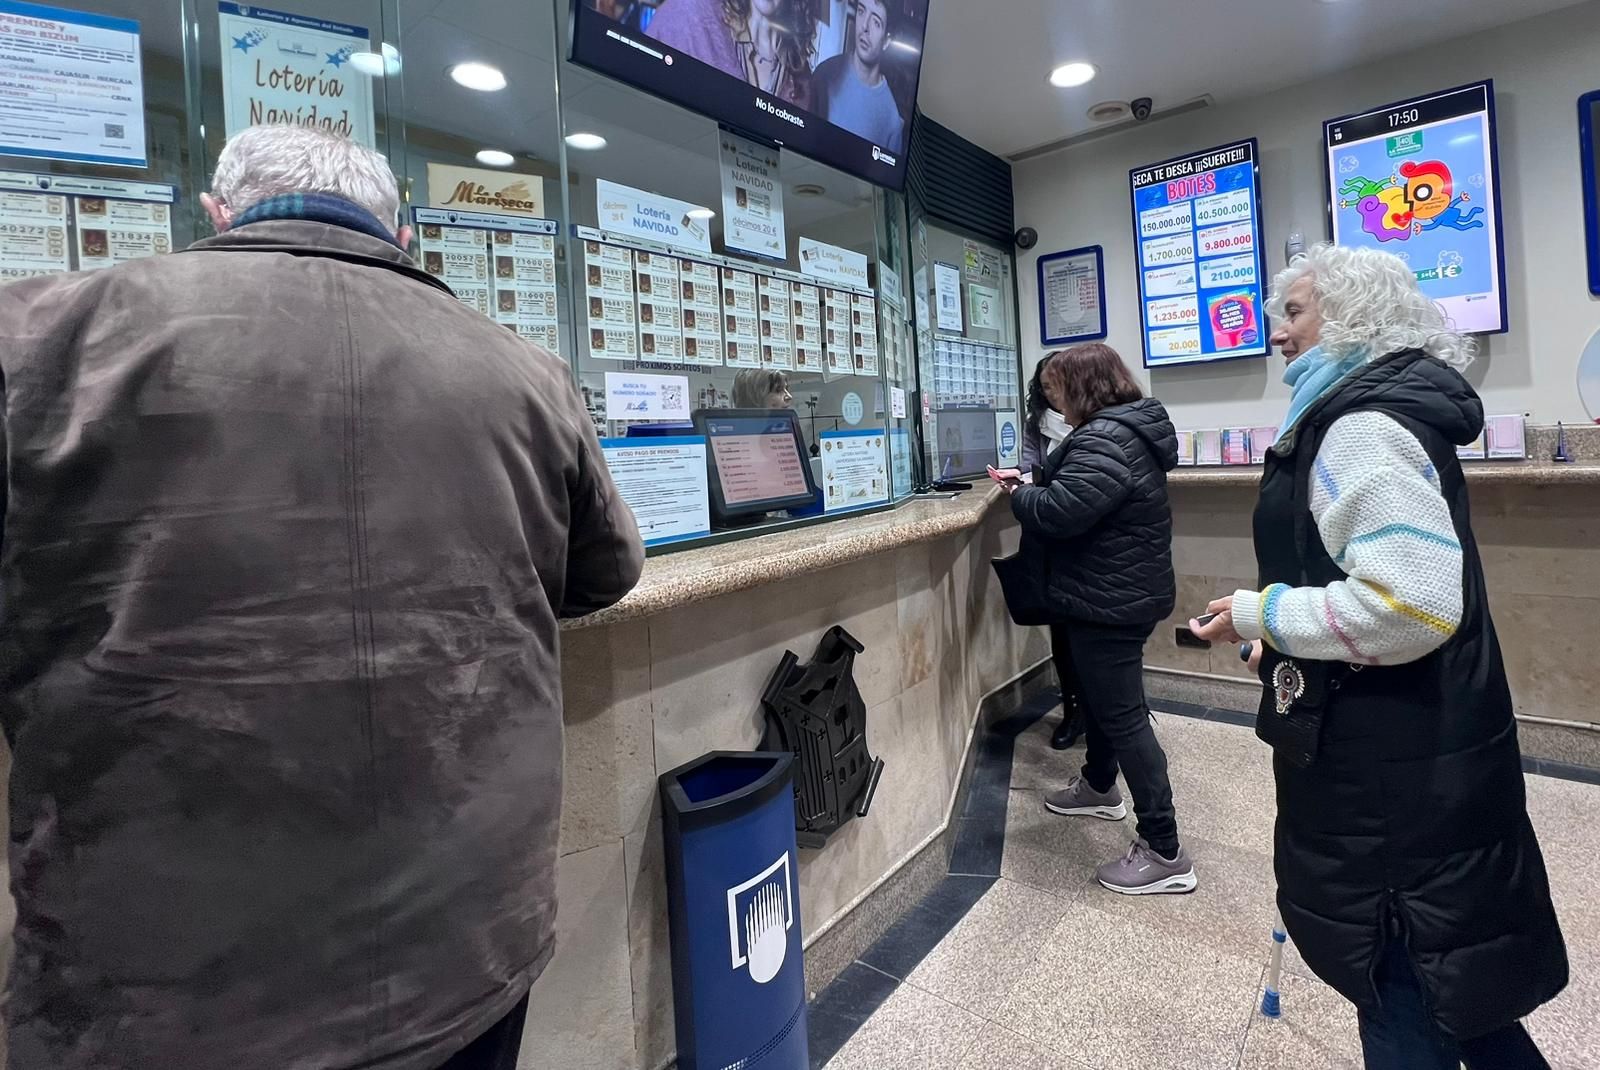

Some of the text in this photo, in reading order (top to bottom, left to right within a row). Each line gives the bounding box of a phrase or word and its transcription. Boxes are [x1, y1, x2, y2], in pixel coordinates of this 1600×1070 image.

[255, 59, 344, 97] Lotería
[755, 97, 805, 128] No lo cobraste.
[1388, 108, 1419, 127] 17:50
[1334, 132, 1342, 140] 19
[736, 157, 769, 177] Lotería
[1154, 168, 1164, 181] TE
[1166, 162, 1193, 179] DESEA
[1195, 148, 1244, 173] ¡¡¡SUERTE!!!
[731, 169, 774, 192] NAVIDAD
[1167, 172, 1216, 201] BOTES
[440, 180, 534, 209] Mariseca
[636, 203, 672, 221] Lotería
[1198, 202, 1249, 220] 40.500.000
[632, 217, 679, 236] NAVIDAD
[1143, 214, 1191, 232] 150.000.000
[1205, 234, 1251, 251] 9.800.000
[1149, 246, 1192, 262] 1.700.000
[1211, 267, 1253, 281] 210.000
[1153, 309, 1196, 322] 1.235.000
[1169, 340, 1199, 350] 20.000
[673, 362, 701, 373] SORTEOS
